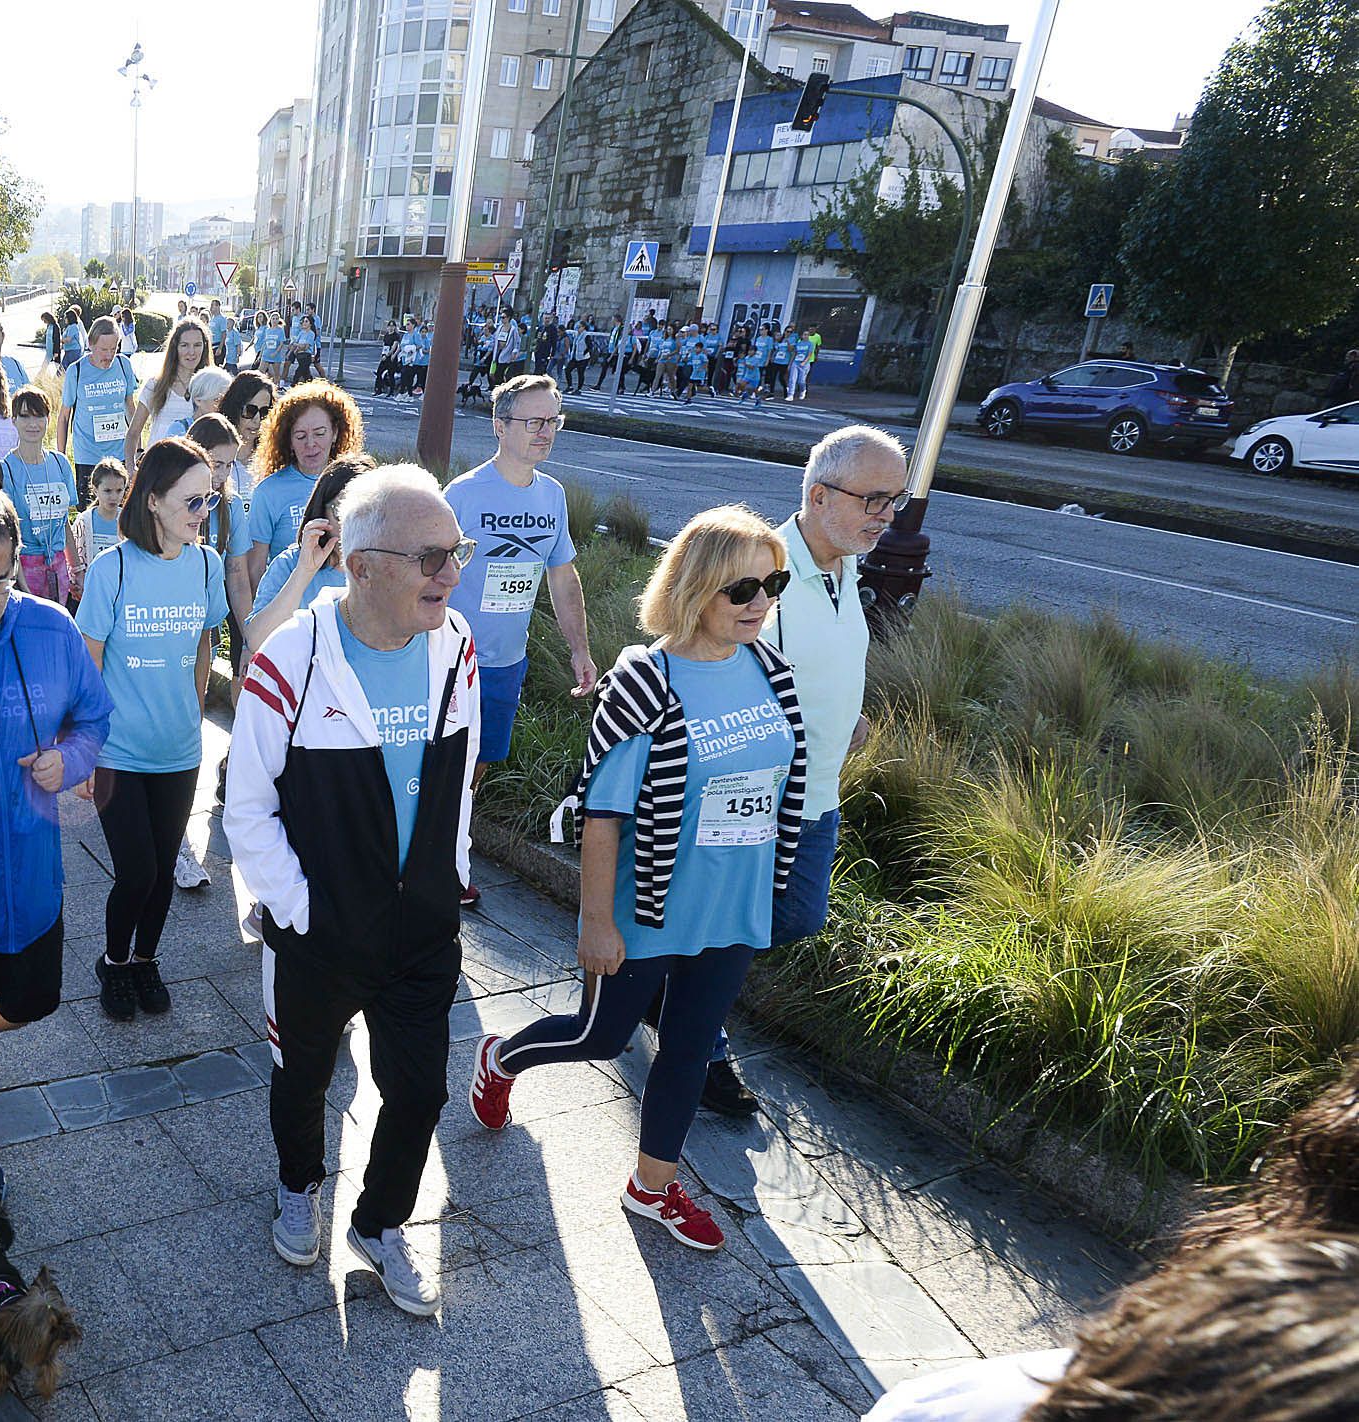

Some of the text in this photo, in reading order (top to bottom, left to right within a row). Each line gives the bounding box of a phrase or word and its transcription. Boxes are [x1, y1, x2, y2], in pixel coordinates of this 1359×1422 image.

[101, 422, 119, 431] 1947
[38, 495, 62, 505] 1745
[481, 512, 556, 531] Reebok
[500, 579, 532, 594] 1592
[125, 602, 206, 620] En marcha
[370, 704, 428, 725] marc
[685, 698, 785, 740] En march
[699, 752, 723, 763] contra
[710, 776, 749, 785] Pontevedra
[706, 789, 723, 797] pola
[726, 795, 772, 817] 1513
